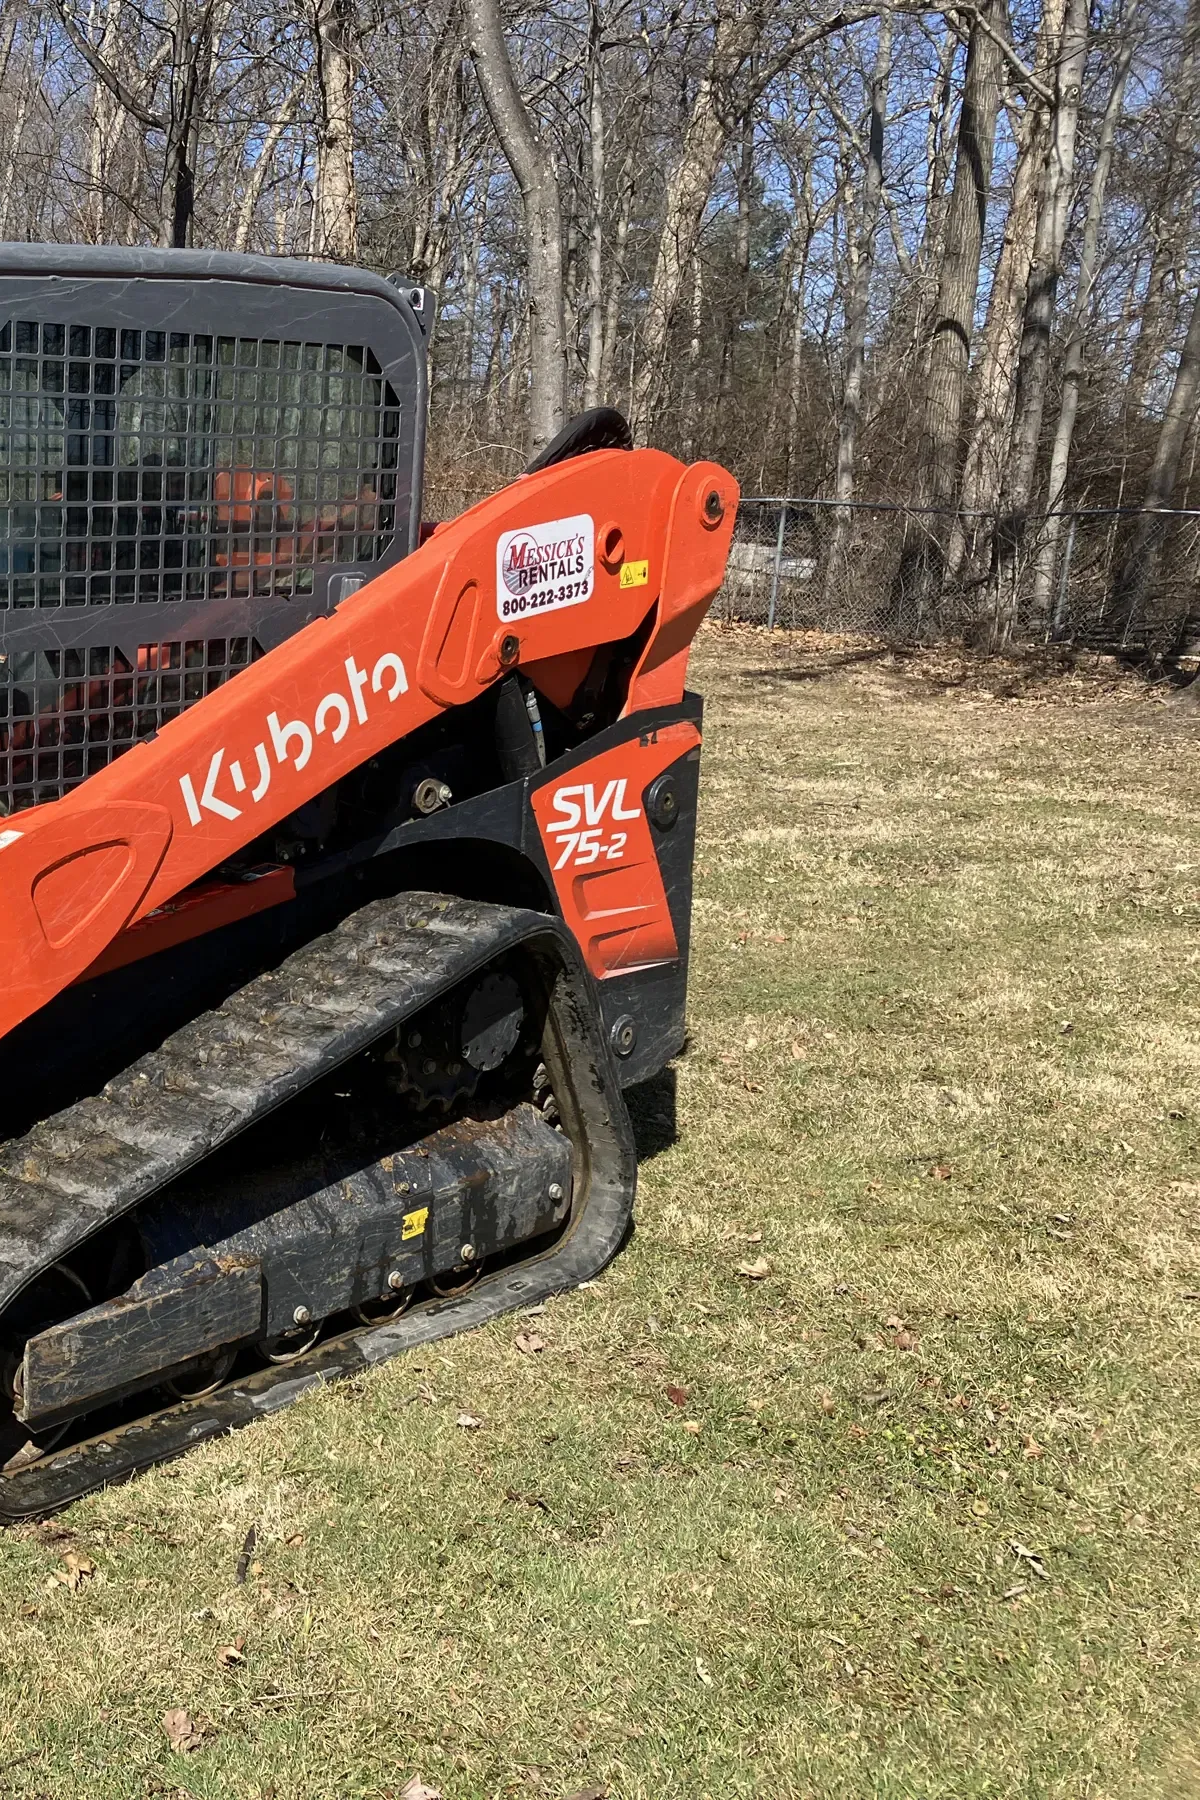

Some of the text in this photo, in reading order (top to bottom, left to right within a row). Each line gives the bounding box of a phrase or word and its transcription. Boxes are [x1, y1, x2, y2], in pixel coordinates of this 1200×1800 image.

[507, 533, 585, 571] MESSICK'S
[518, 556, 584, 588] RENTALS
[502, 580, 589, 616] 800-222-3373
[179, 652, 409, 827] Kubota
[546, 778, 641, 833] SVL
[553, 828, 628, 870] 75-2
